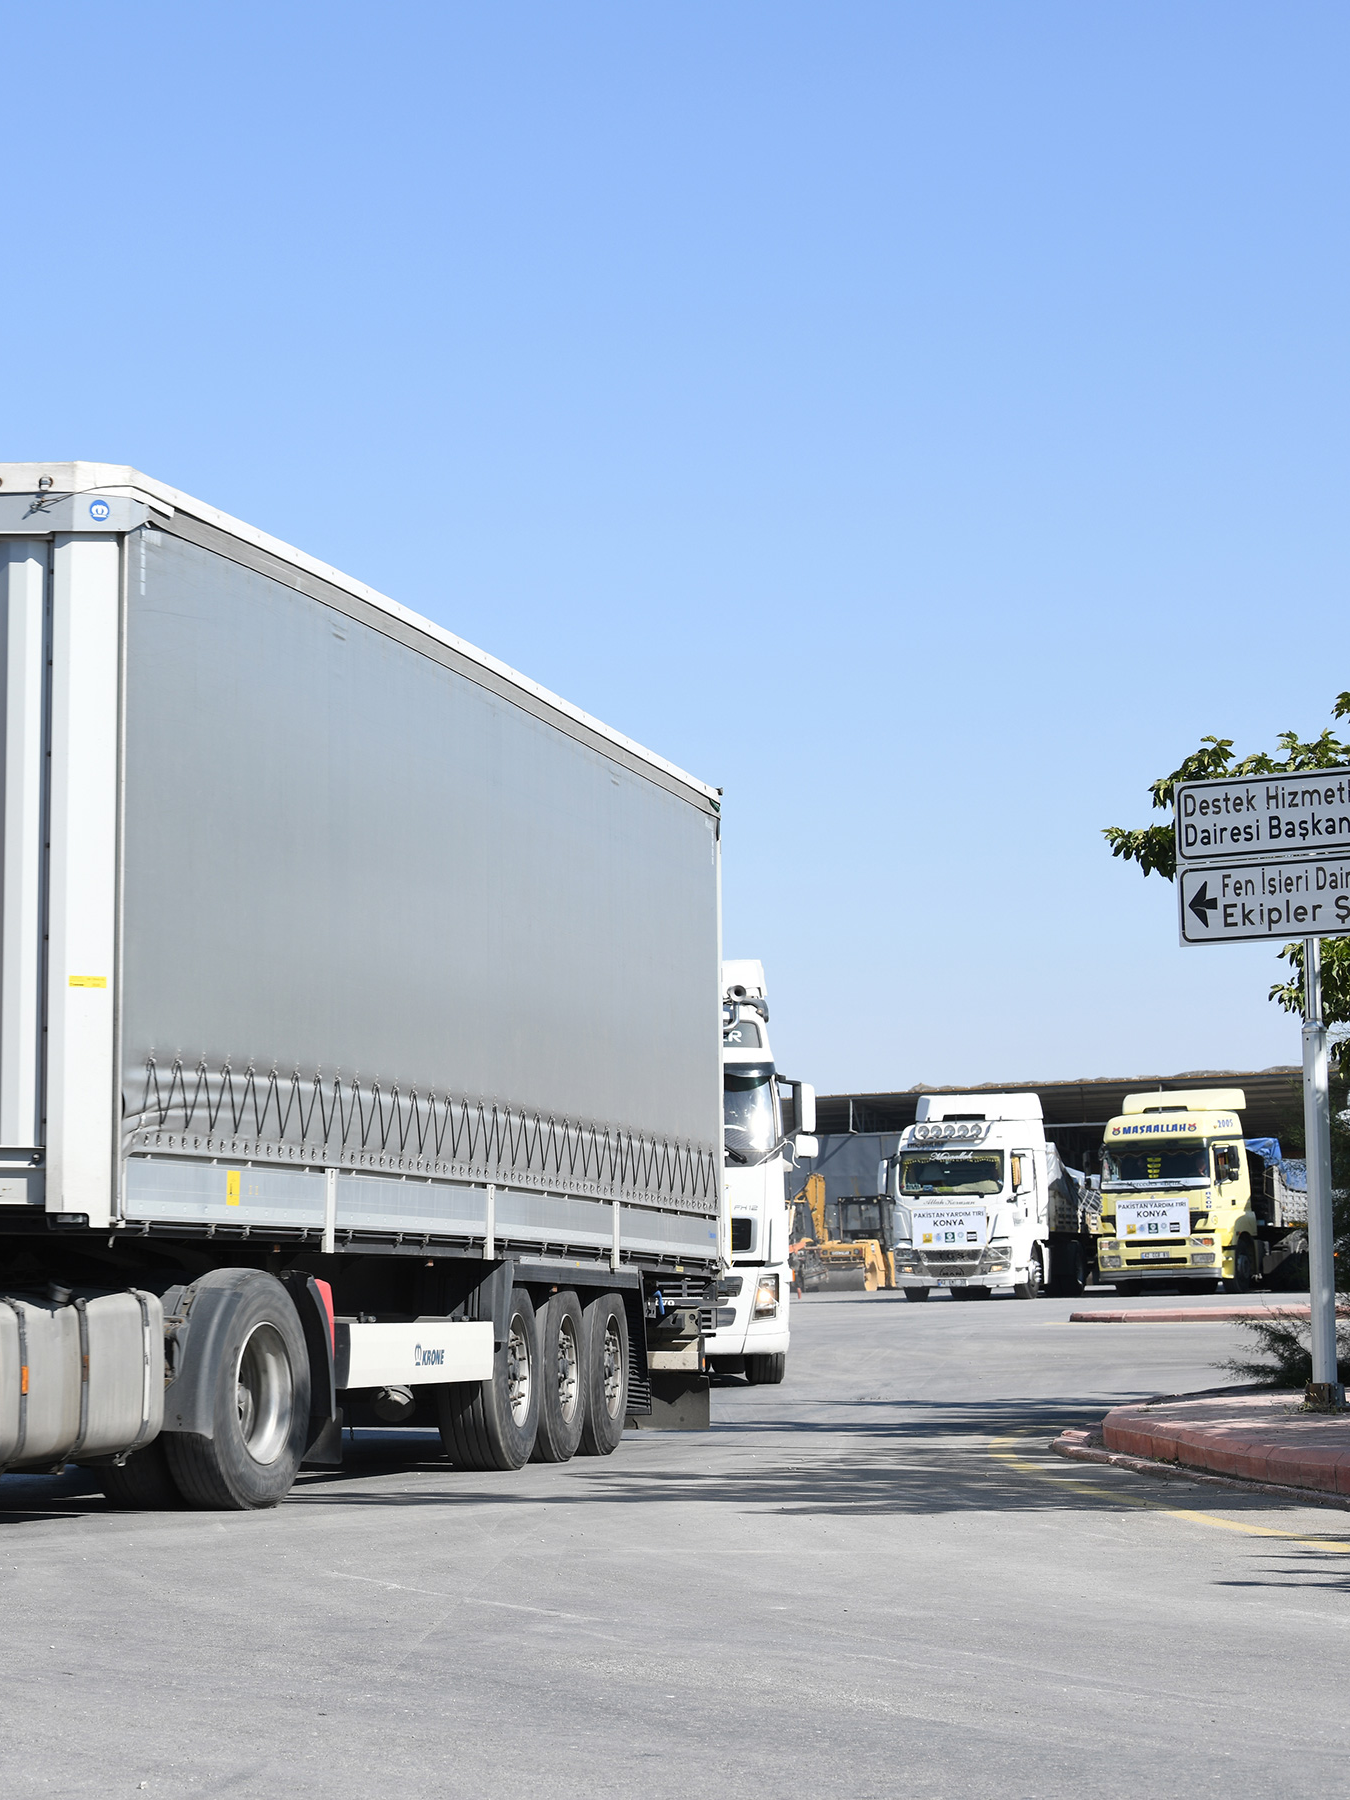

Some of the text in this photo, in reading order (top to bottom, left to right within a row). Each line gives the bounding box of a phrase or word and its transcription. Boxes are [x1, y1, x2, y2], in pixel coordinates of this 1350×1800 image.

[1183, 788, 1257, 817] Destek
[1184, 812, 1350, 847] Dairesi Başkan
[1222, 873, 1255, 898] Fen
[1315, 866, 1350, 891] Dair
[1223, 899, 1323, 932] Ekipler
[1217, 1119, 1233, 1128] 2005
[933, 1219, 965, 1227] KONYA
[1136, 1210, 1168, 1218] KONYA
[422, 1349, 445, 1365] KRONE
